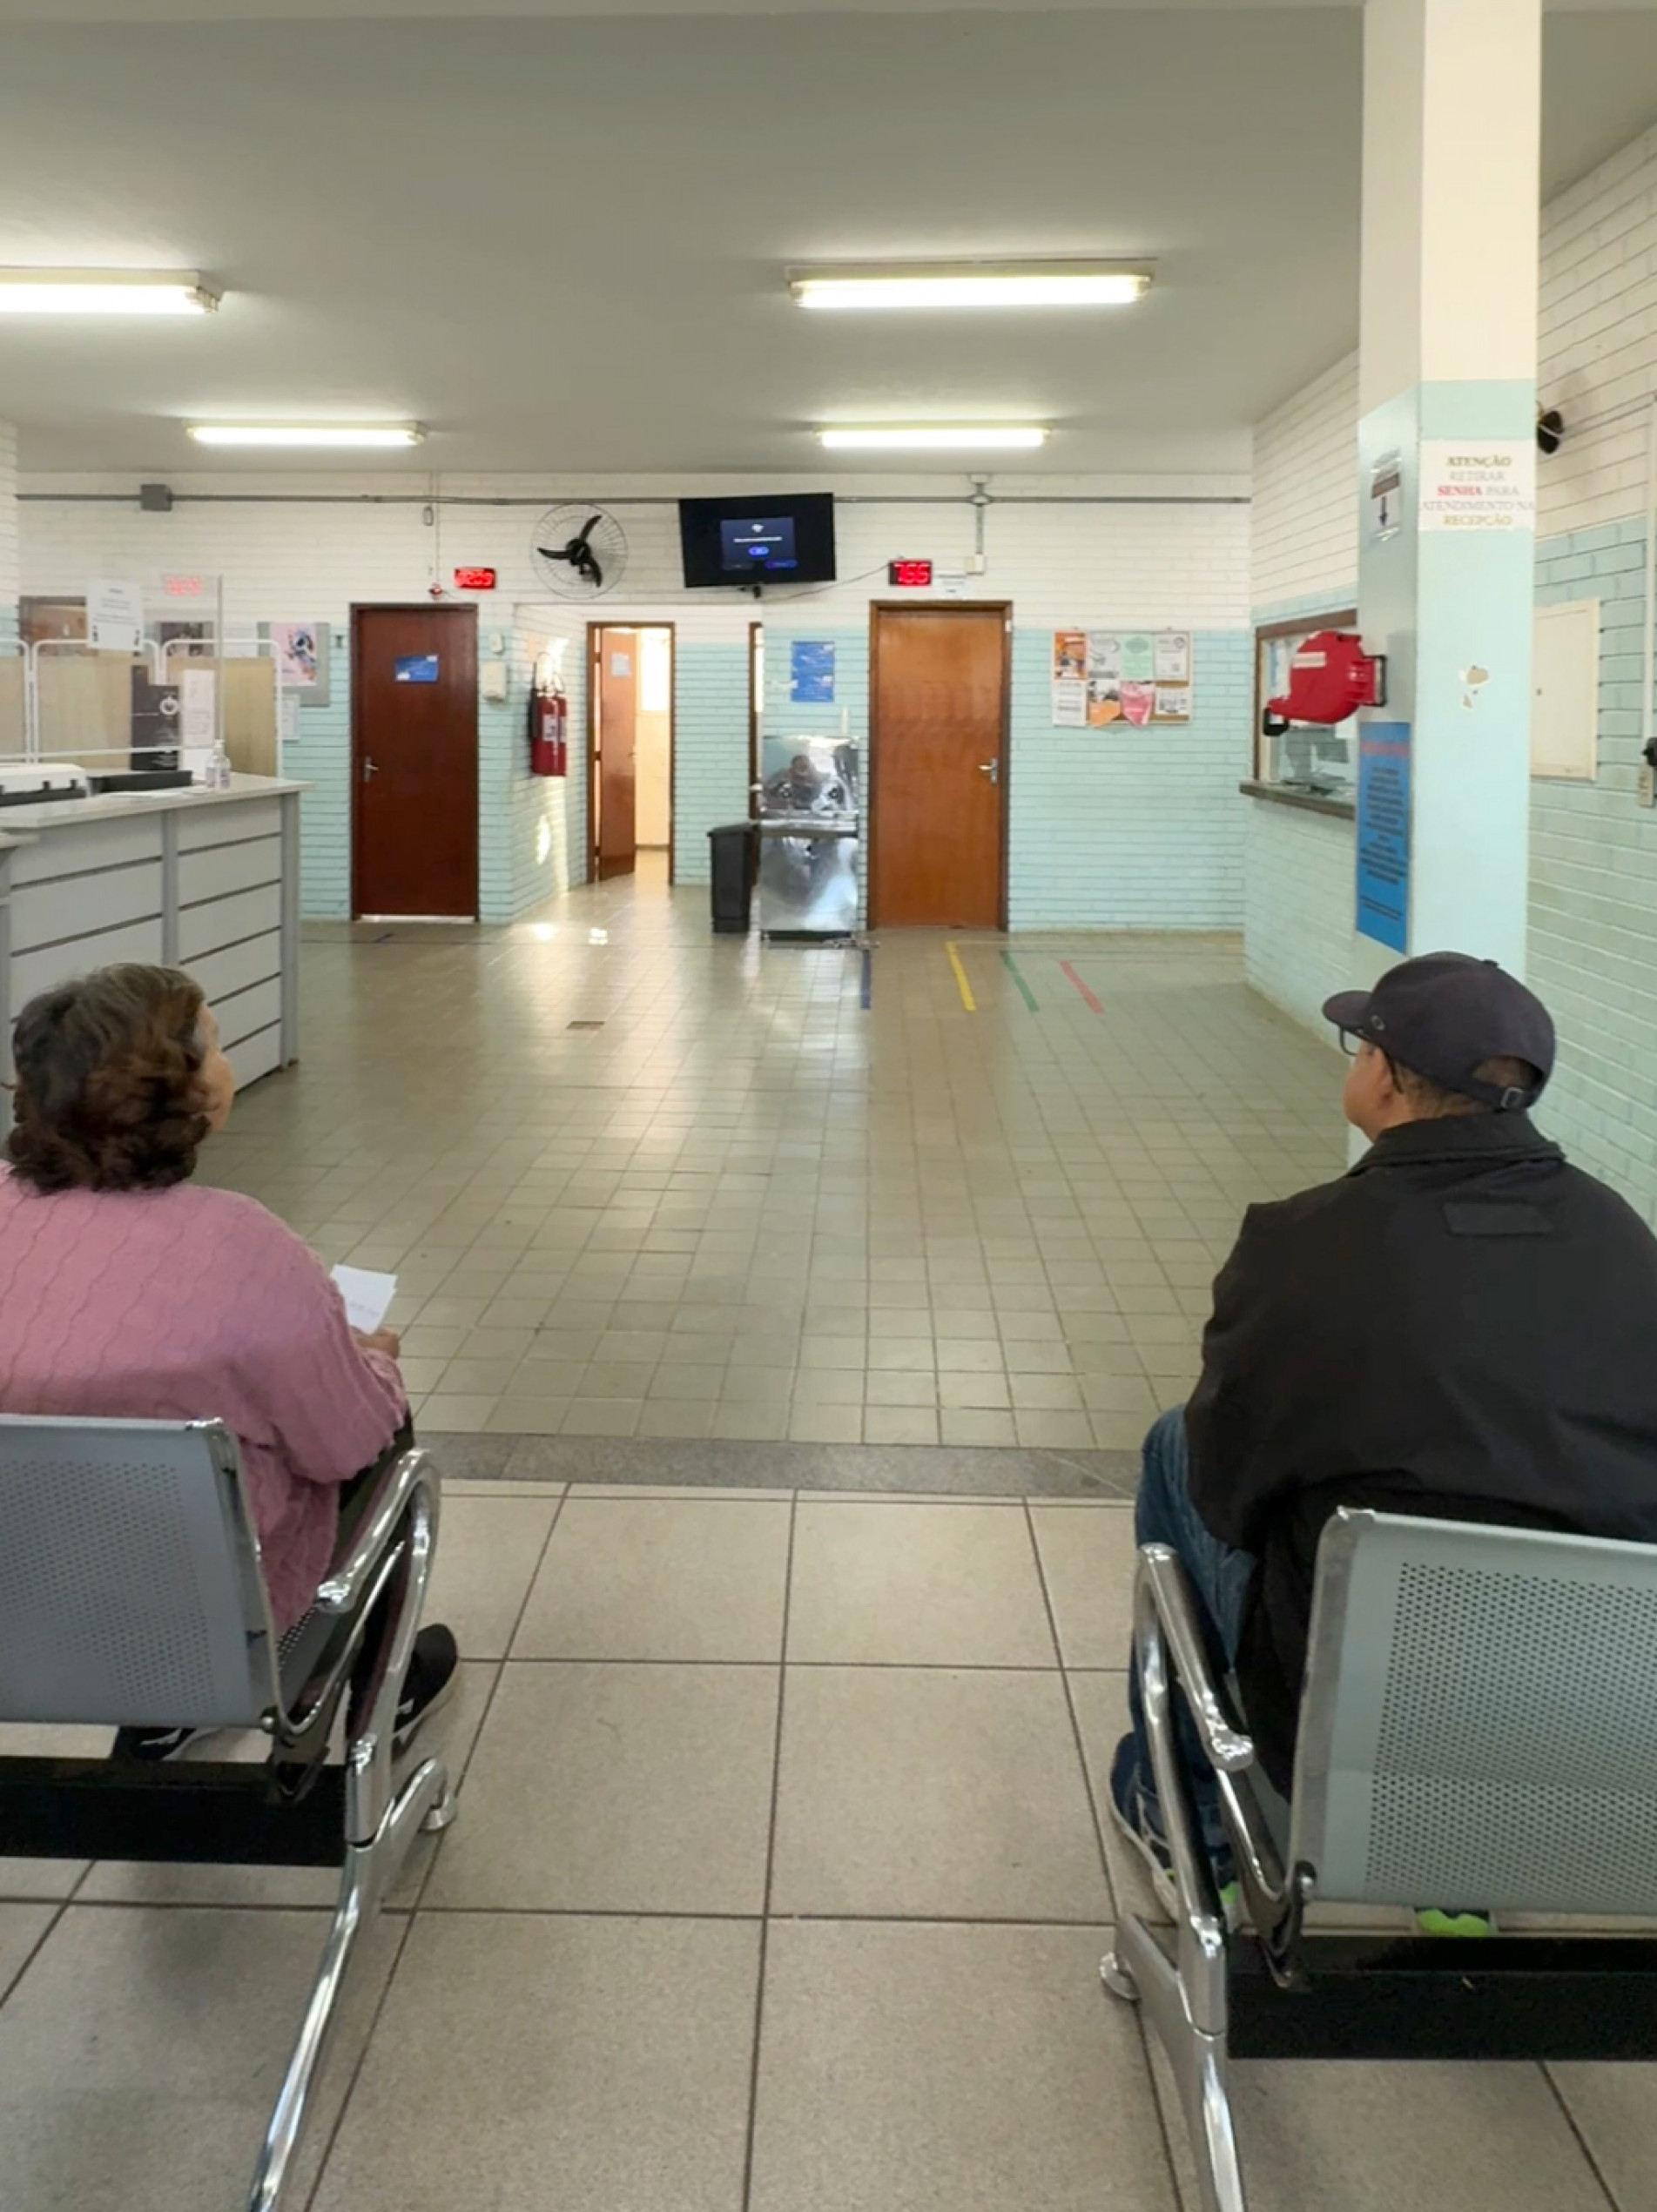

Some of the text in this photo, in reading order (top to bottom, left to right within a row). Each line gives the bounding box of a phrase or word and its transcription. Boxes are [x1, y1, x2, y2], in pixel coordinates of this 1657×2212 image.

[1446, 454, 1512, 467] ATENÇÃO
[1450, 471, 1505, 481] RETIRAR
[1438, 485, 1520, 495] SENHA PARA
[1421, 501, 1513, 511] ATENDIMENTO
[1443, 514, 1512, 526] RECEPÇÃO
